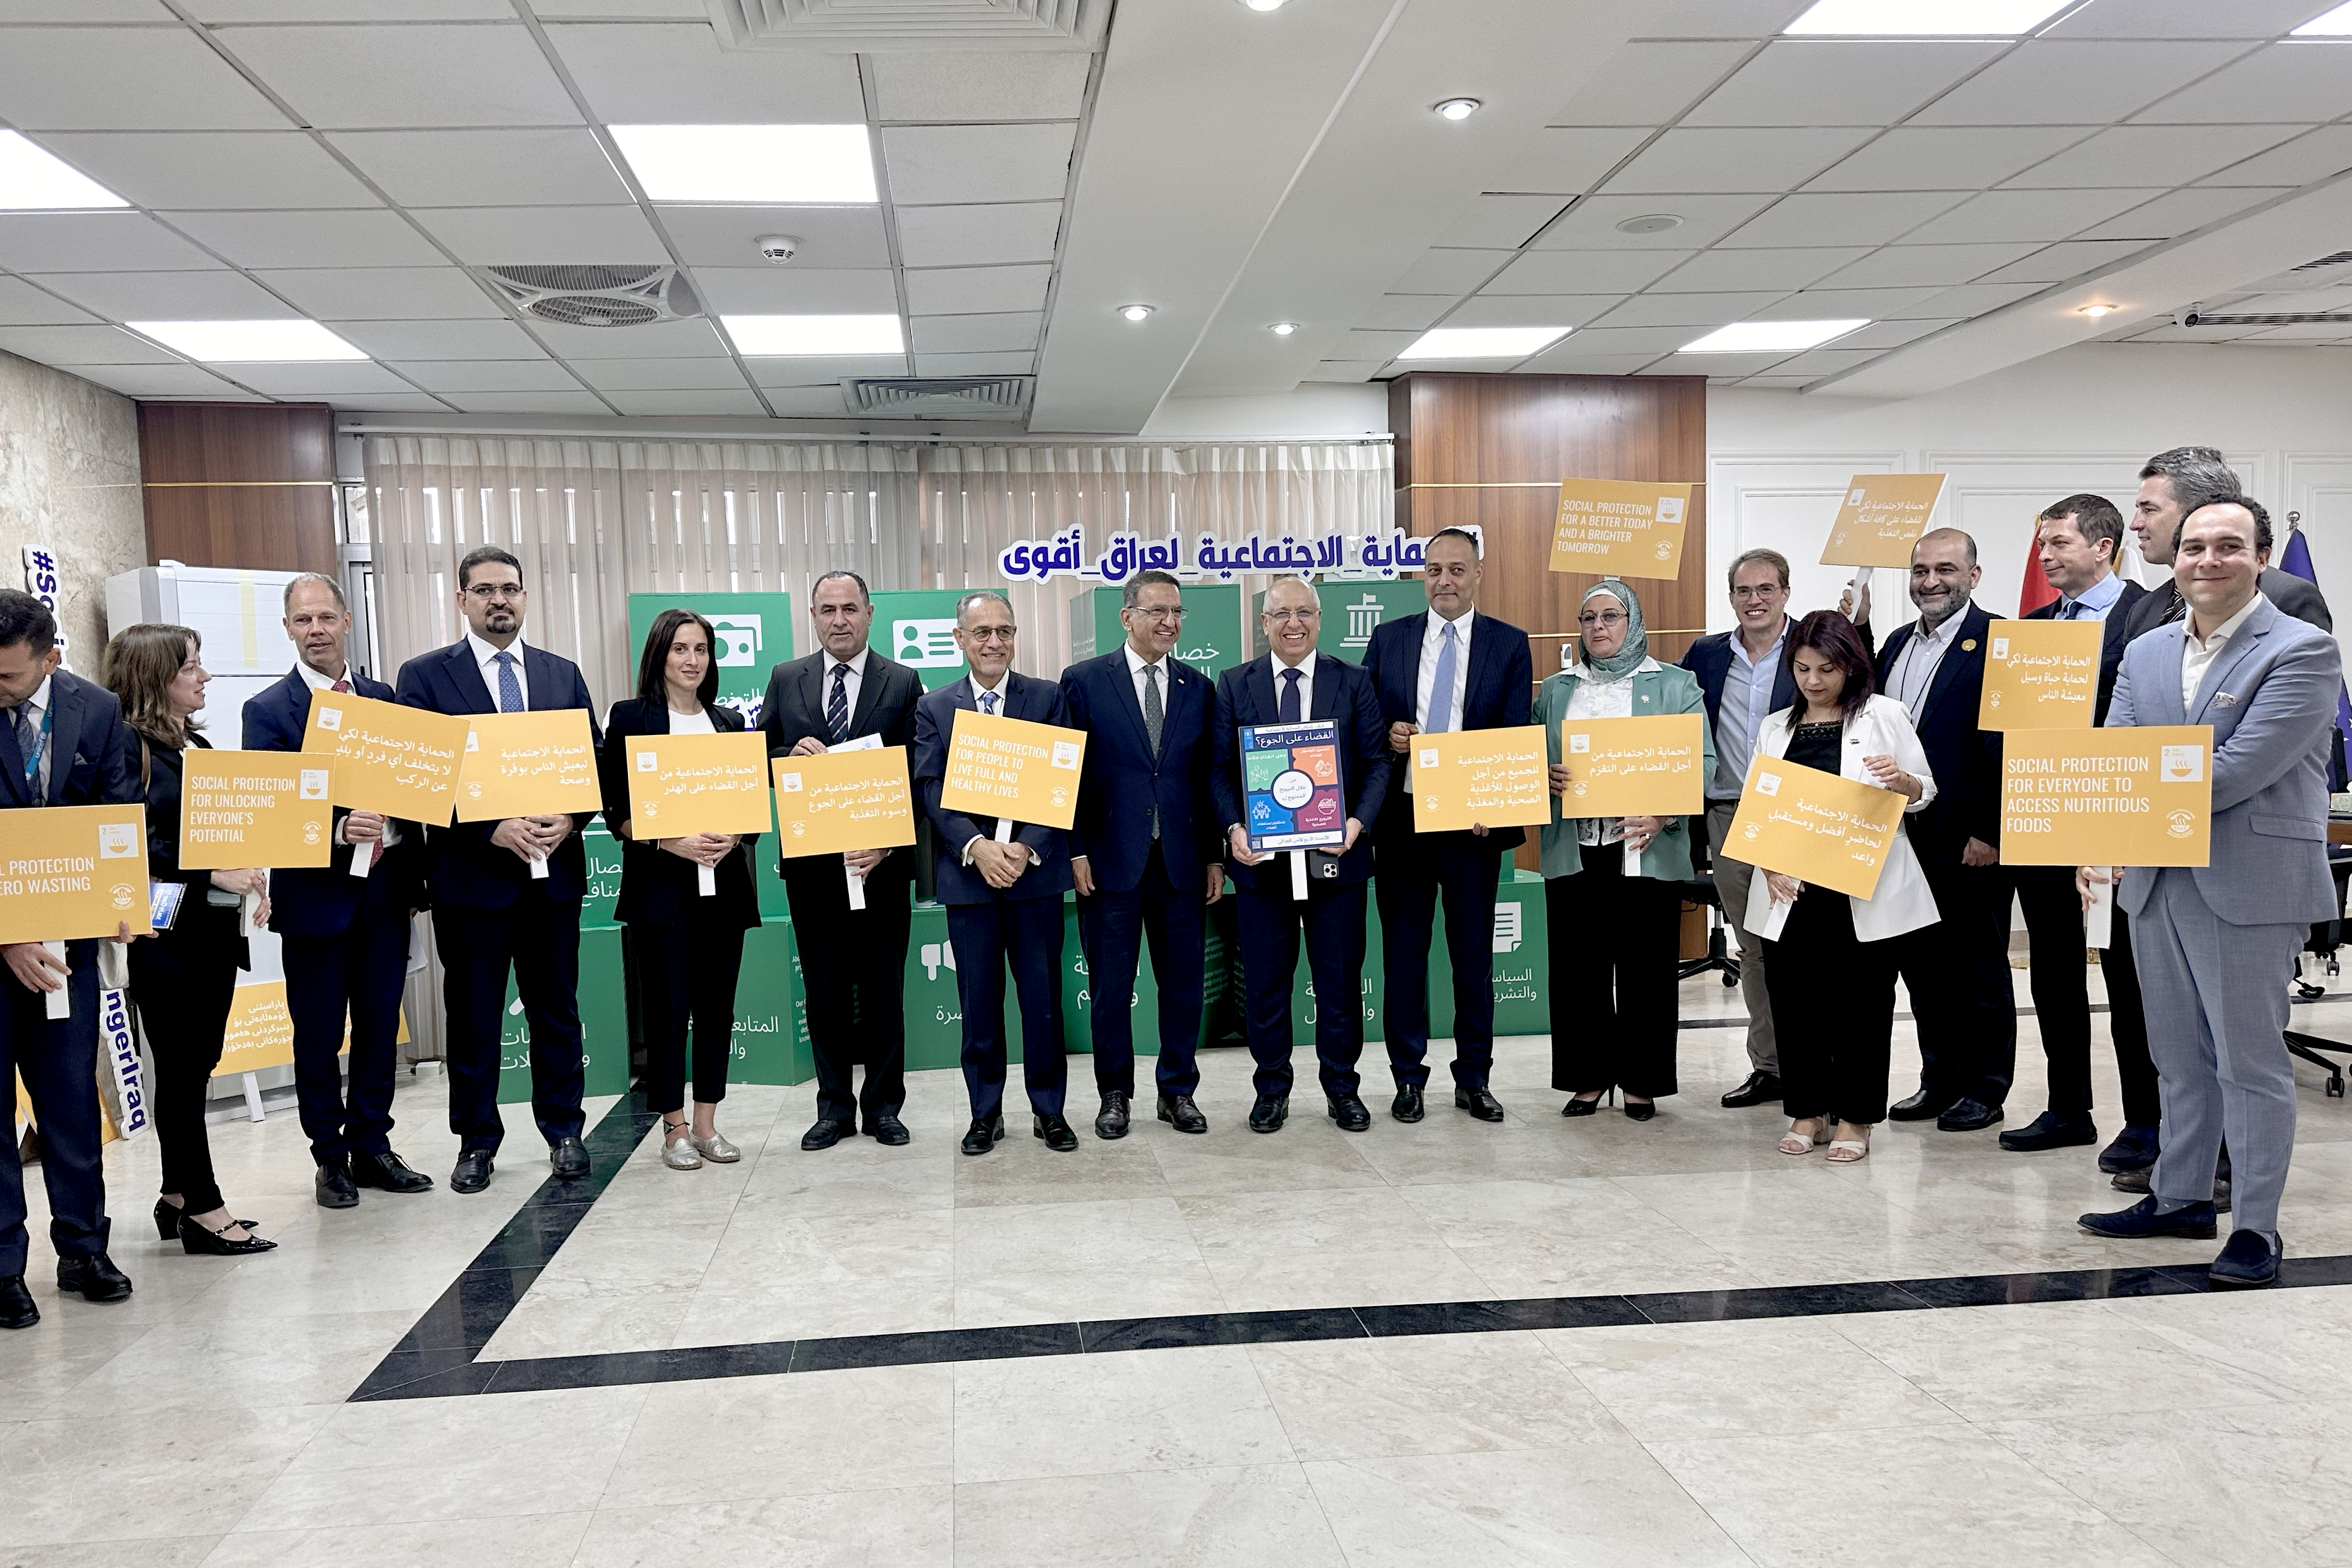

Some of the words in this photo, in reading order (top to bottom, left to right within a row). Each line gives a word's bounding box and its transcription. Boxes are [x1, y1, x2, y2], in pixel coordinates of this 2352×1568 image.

[1563, 500, 1594, 512] SOCIAL
[1597, 502, 1652, 516] PROTECTION
[1872, 501, 1904, 511] الاجتماعية
[1905, 501, 1928, 512] الحماية
[1561, 513, 1578, 525] FOR
[1580, 516, 1586, 525] A
[1589, 516, 1620, 528] BETTER
[1624, 518, 1653, 530] TODAY
[1886, 516, 1899, 526] على
[1559, 528, 1577, 538] AND
[1579, 529, 1585, 539] A
[1588, 529, 1632, 543] BRIGHTER
[1557, 541, 1609, 555] TOMORROW
[2006, 653, 2021, 669] لكي
[2022, 654, 2061, 667] الاجتماعية
[2063, 656, 2091, 669] الحماية
[2021, 671, 2042, 684] وسبل
[2044, 672, 2061, 684] حياة
[2063, 673, 2088, 685] لحماية
[2038, 690, 2059, 702] الناس
[2060, 690, 2086, 703] معيشة
[338, 728, 358, 742] لكي
[361, 731, 415, 751] الاجتماعية
[1255, 734, 1284, 748] الجوع؟
[1286, 733, 1303, 745] على
[1304, 730, 1334, 741] القضاء
[353, 746, 365, 759] أو
[418, 743, 454, 759] الحماية
[553, 745, 586, 758] الحماية
[958, 733, 990, 750] SOCIAL
[993, 739, 1049, 760] PROTECTION
[1657, 747, 1690, 758] الحماية
[388, 753, 402, 768] أي
[501, 747, 550, 761] الاجتماعية
[955, 748, 973, 762] FOR
[975, 751, 1009, 768] PEOPLE
[1012, 757, 1023, 770] TO
[1458, 753, 1504, 767] الاجتماعية
[1506, 751, 1538, 764] الحماية
[1591, 752, 1604, 762] من
[1607, 748, 1655, 761] الاجتماعية
[404, 759, 439, 775] يتخلف
[443, 765, 451, 775] لا
[501, 763, 528, 777] بوفرة
[531, 762, 555, 775] الناس
[558, 760, 587, 773] ليعيش
[726, 765, 757, 777] الحماية
[1589, 764, 1616, 777] التقزم
[1620, 764, 1637, 775] على
[1639, 762, 1670, 772] القضاء
[1672, 759, 1691, 773] أجل
[2007, 758, 2056, 773] SOCIAL
[2061, 757, 2148, 773] PROTECTION
[659, 771, 672, 780] من
[676, 766, 723, 779] الاجتماعية
[953, 763, 972, 776] LIVE
[975, 766, 996, 780] FULL
[998, 770, 1018, 784] AND
[1472, 767, 1490, 781] أجل
[1492, 771, 1505, 780] من
[1508, 765, 1539, 780] للجميع
[191, 776, 230, 790] SOCIAL
[233, 777, 296, 791] PROTECTION
[396, 774, 429, 788] الركب
[431, 782, 448, 792] عن
[559, 775, 591, 786] وصحة
[709, 780, 738, 791] القضاء
[741, 777, 758, 791] أجل
[824, 779, 870, 795] الاجتماعية
[872, 776, 903, 789] الحماية
[1505, 780, 1540, 792] الوصول
[2007, 778, 2033, 793] FOR
[2038, 778, 2109, 793] EVERYONE
[2114, 777, 2132, 792] TO
[663, 783, 686, 795] الهدر
[689, 782, 706, 794] على
[810, 788, 822, 797] من
[951, 777, 992, 794] HEALTHY
[994, 785, 1019, 799] LIVES
[1470, 781, 1502, 795] للأغذية
[191, 794, 211, 807] FOR
[215, 795, 275, 808] UNLOCKING
[838, 797, 854, 808] على
[857, 793, 885, 804] القضاء
[888, 789, 905, 803] أجل
[1507, 795, 1541, 805] الصحية
[808, 798, 836, 813] الجوع
[1466, 797, 1504, 810] والمغذية
[1796, 798, 1849, 821] الاجتماعية
[2006, 798, 2060, 813] ACCESS
[2064, 797, 2149, 813] NUTRITIOUS
[850, 808, 879, 821] التغذية
[882, 808, 907, 819] وسوء
[1816, 823, 1846, 838] أفضل
[1850, 814, 1888, 834] الحماية
[2006, 818, 2051, 833] FOODS
[189, 829, 245, 843] POTENTIAL
[1851, 852, 1875, 866] واعد
[9, 857, 94, 875] PROTECTION
[28, 876, 90, 894] WASTING
